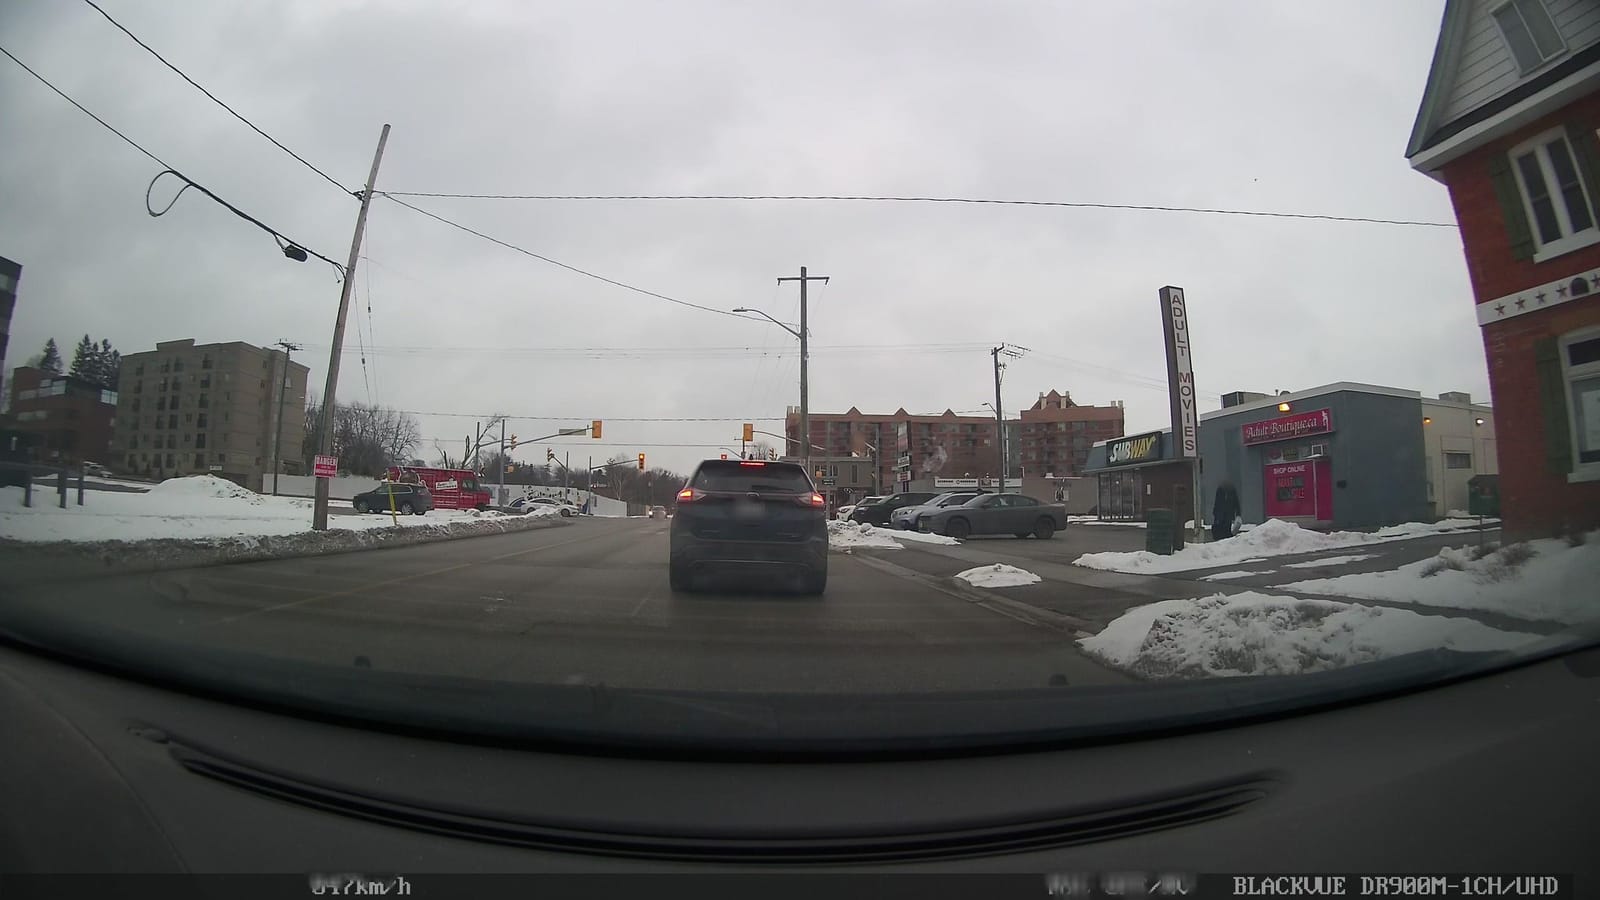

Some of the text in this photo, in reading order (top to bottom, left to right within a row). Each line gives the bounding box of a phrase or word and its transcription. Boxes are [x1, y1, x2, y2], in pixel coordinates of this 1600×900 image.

[1172, 295, 1195, 451] ADULT MOVIES
[1247, 418, 1317, 438] Adult Boutique.ca
[1110, 435, 1156, 462] SUBWAY
[1273, 465, 1306, 475] SHOP ONLINE
